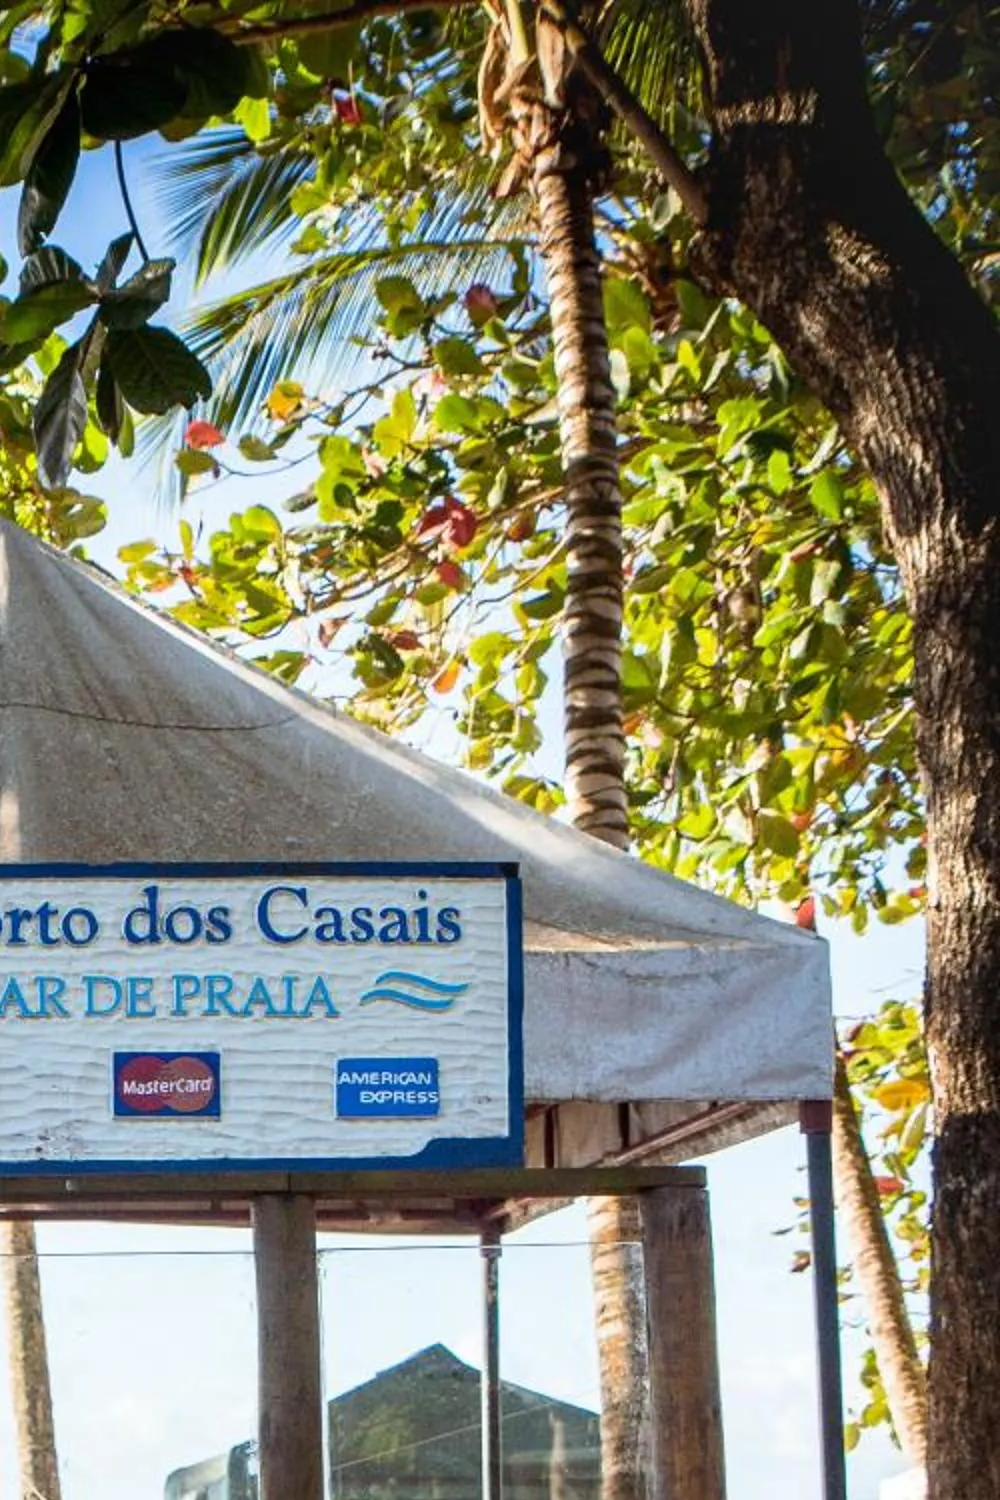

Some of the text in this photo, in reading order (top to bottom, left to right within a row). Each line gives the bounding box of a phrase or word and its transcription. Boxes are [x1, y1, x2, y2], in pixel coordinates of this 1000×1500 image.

[123, 885, 233, 945] dos
[256, 885, 463, 945] Casais
[81, 975, 157, 1018] DE
[171, 974, 340, 1018] PRAIA
[122, 1075, 214, 1097] MasterCard
[338, 1071, 432, 1086] AMERICAN
[359, 1090, 440, 1105] EXPRESS
